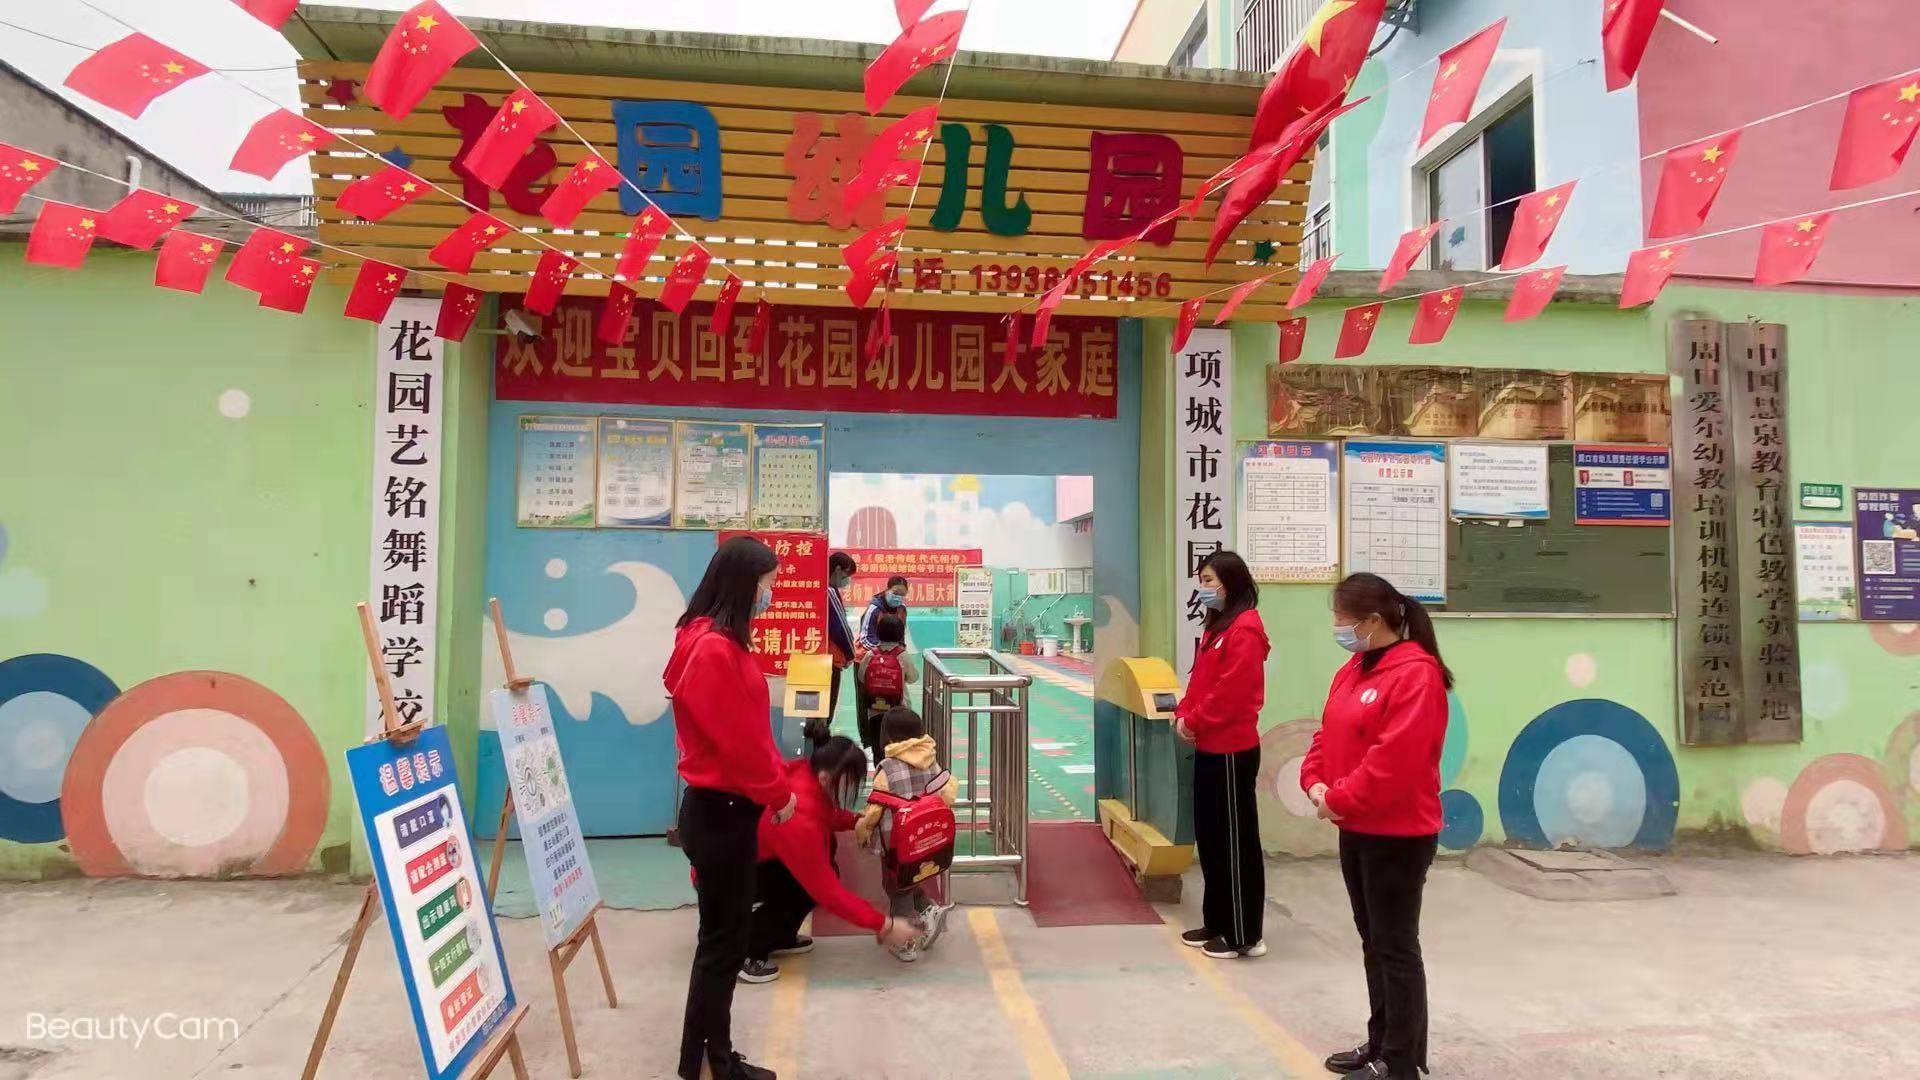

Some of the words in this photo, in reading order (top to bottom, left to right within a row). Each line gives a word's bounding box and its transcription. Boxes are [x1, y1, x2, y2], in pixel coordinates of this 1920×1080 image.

[503, 306, 1114, 397] 欢迎宝贝回到花园幼儿园大家庭
